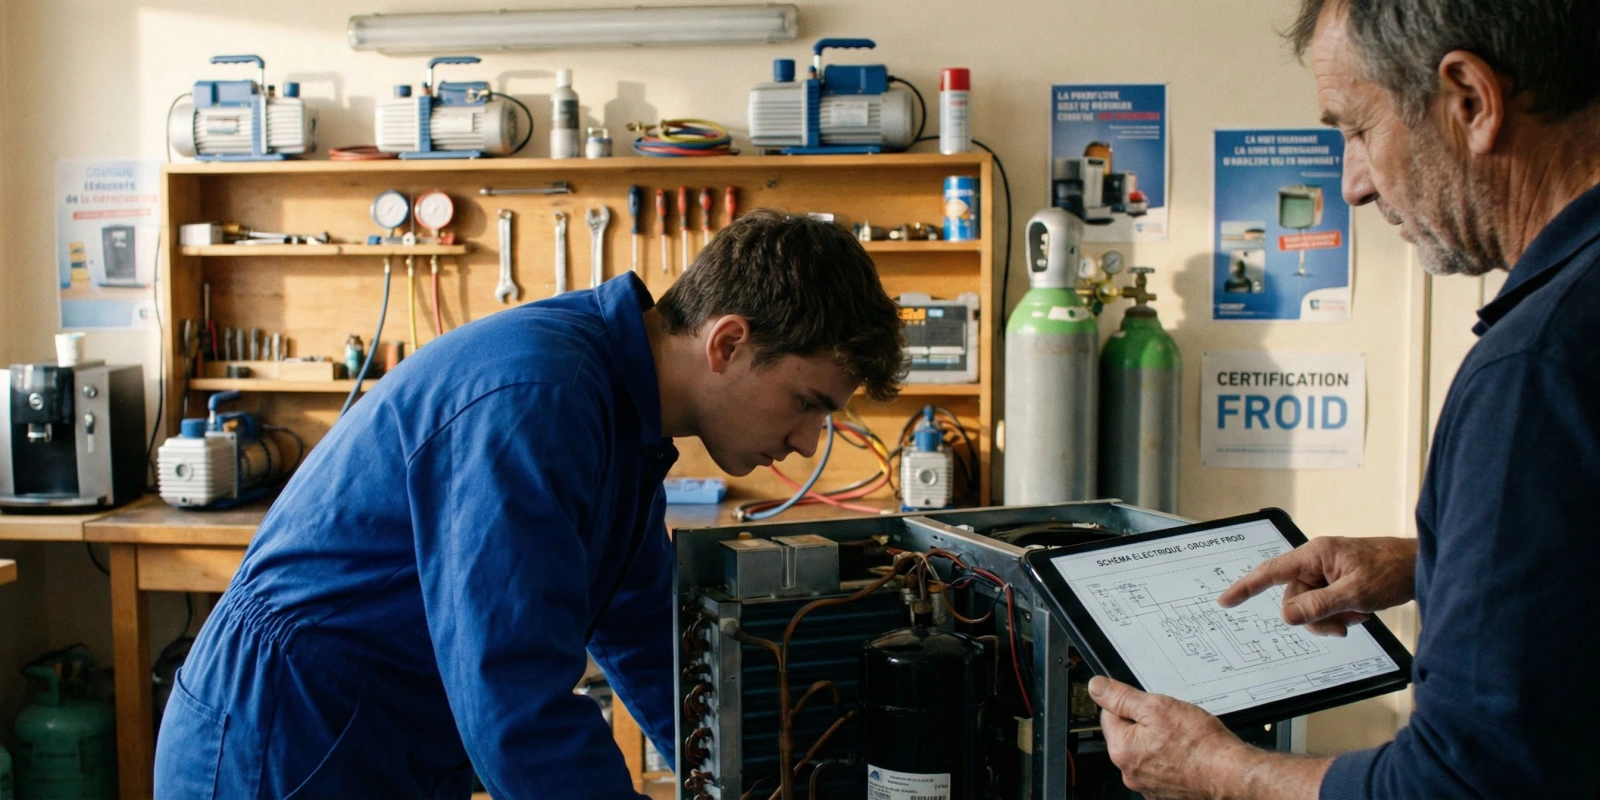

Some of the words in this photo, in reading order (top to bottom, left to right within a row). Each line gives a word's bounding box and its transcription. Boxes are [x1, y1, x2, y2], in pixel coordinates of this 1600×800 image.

[1217, 371, 1349, 387] CERTIFICATION
[1217, 394, 1348, 430] FROID
[1187, 538, 1221, 550] GROUPE
[1220, 533, 1246, 543] FROID
